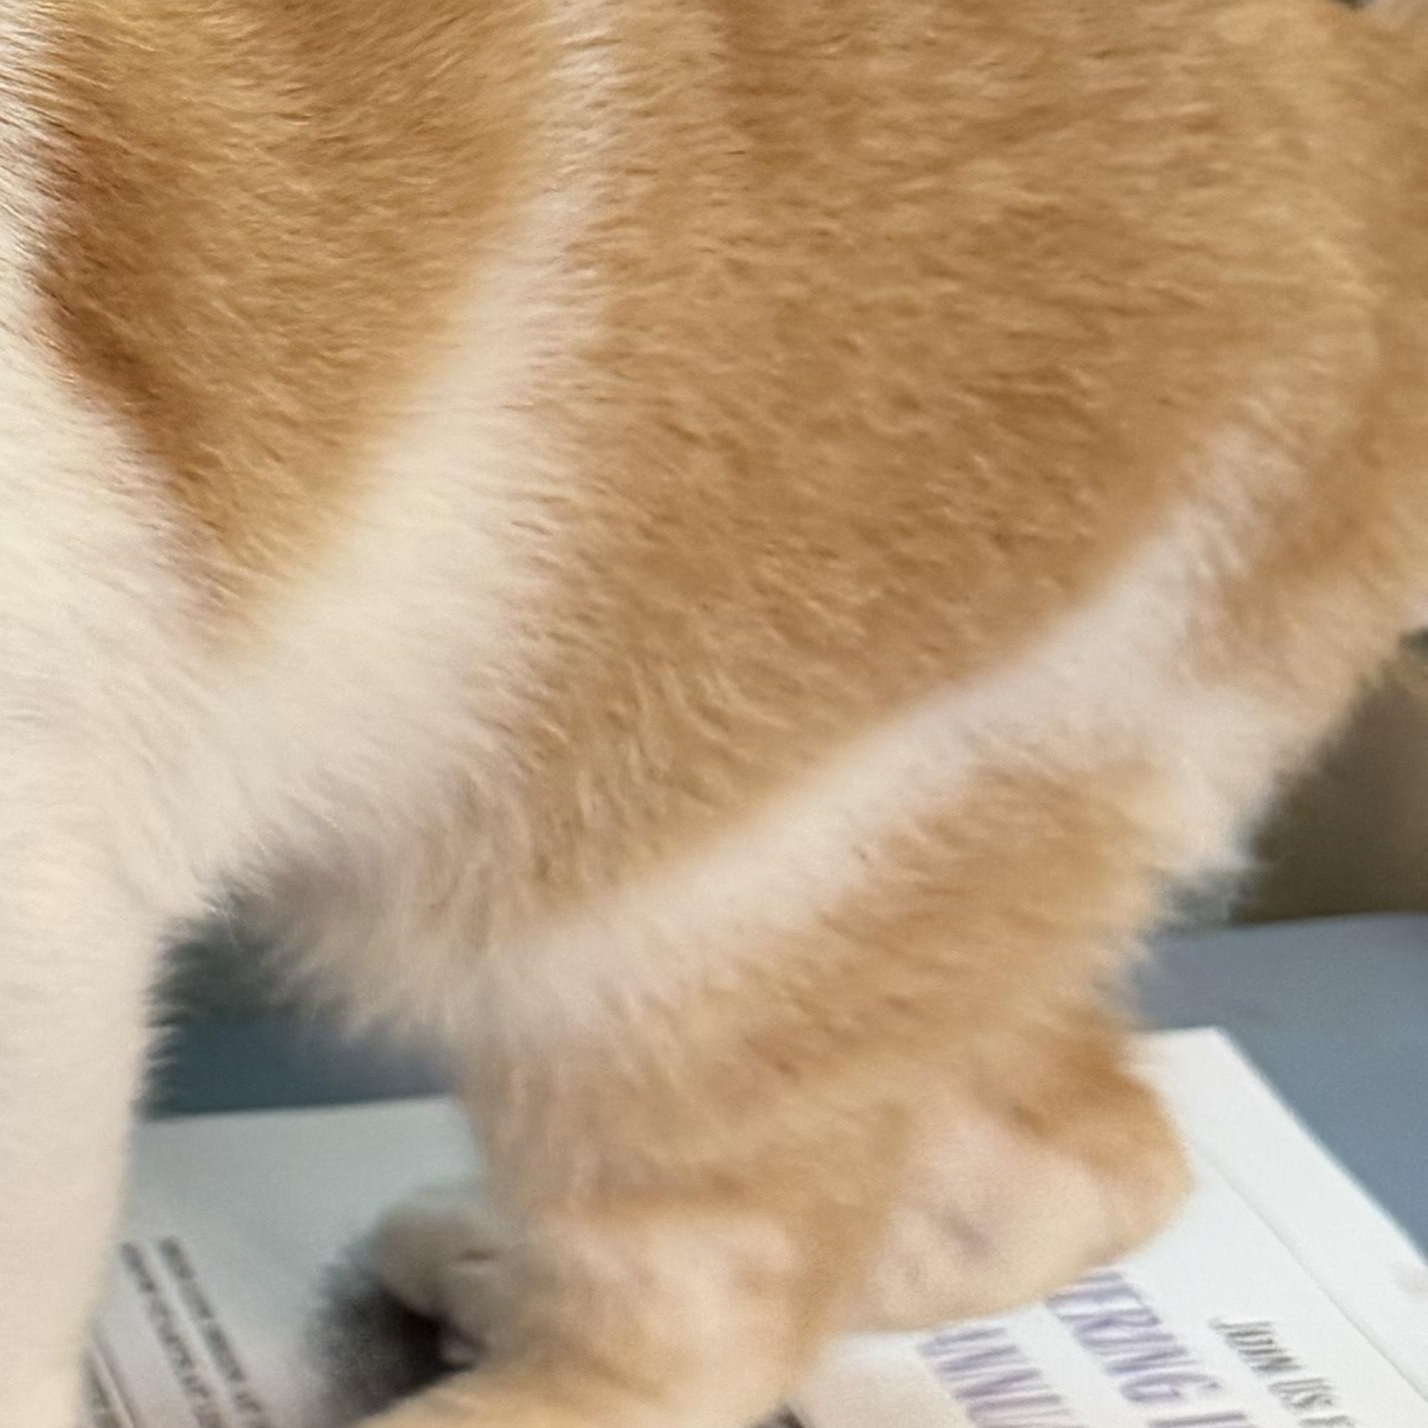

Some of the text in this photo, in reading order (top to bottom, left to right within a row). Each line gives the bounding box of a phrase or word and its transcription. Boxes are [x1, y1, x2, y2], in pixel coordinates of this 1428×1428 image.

[1045, 1270, 1221, 1405] ERING
[1207, 1316, 1306, 1376] JOIN
[1267, 1377, 1335, 1414] US
